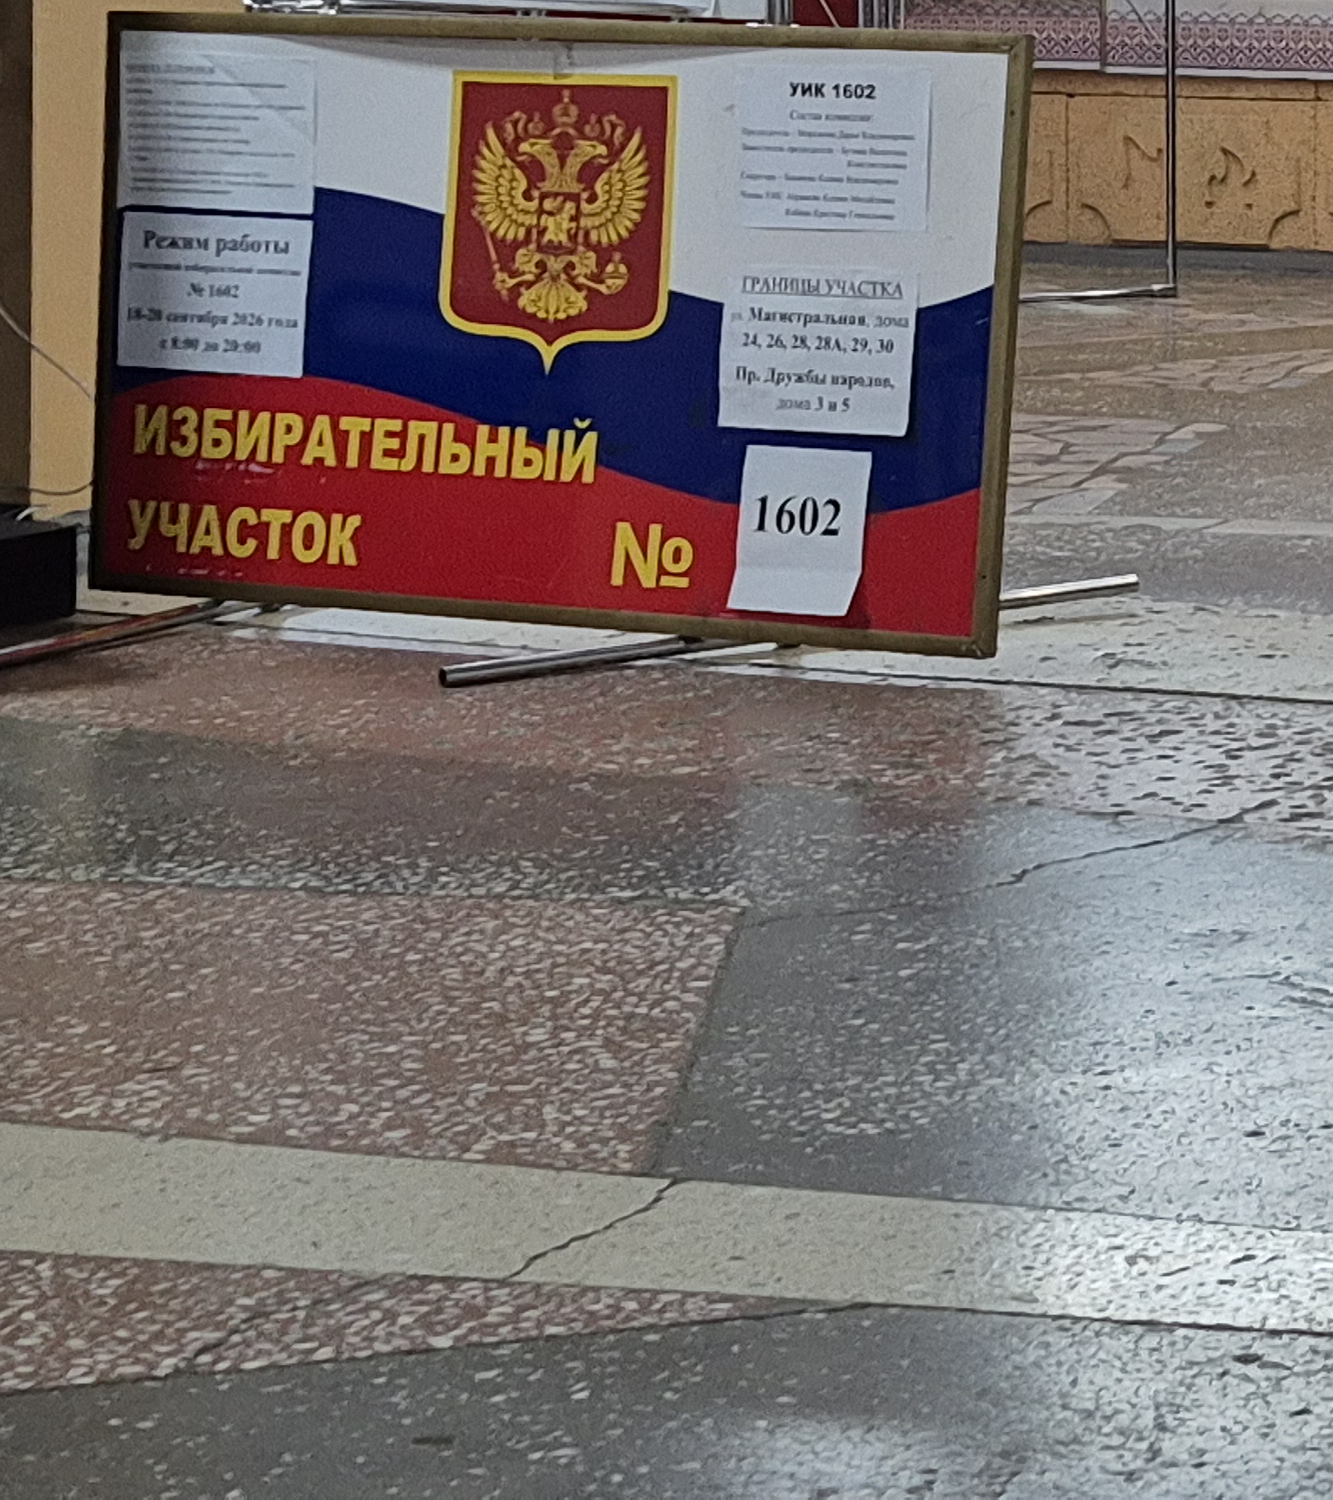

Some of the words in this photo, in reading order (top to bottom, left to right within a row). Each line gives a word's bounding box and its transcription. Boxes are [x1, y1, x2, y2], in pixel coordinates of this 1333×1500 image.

[789, 81, 826, 98] УИК
[832, 84, 877, 100] 1602
[143, 230, 210, 252] Режим
[214, 233, 290, 258] работы
[824, 278, 903, 298] УЧАСТКА
[132, 402, 600, 485] ИЗБИРАТЕЛЬНЫЙ
[753, 492, 843, 538] 1602
[128, 499, 362, 567] УЧАСТОК
[610, 521, 695, 590] №
